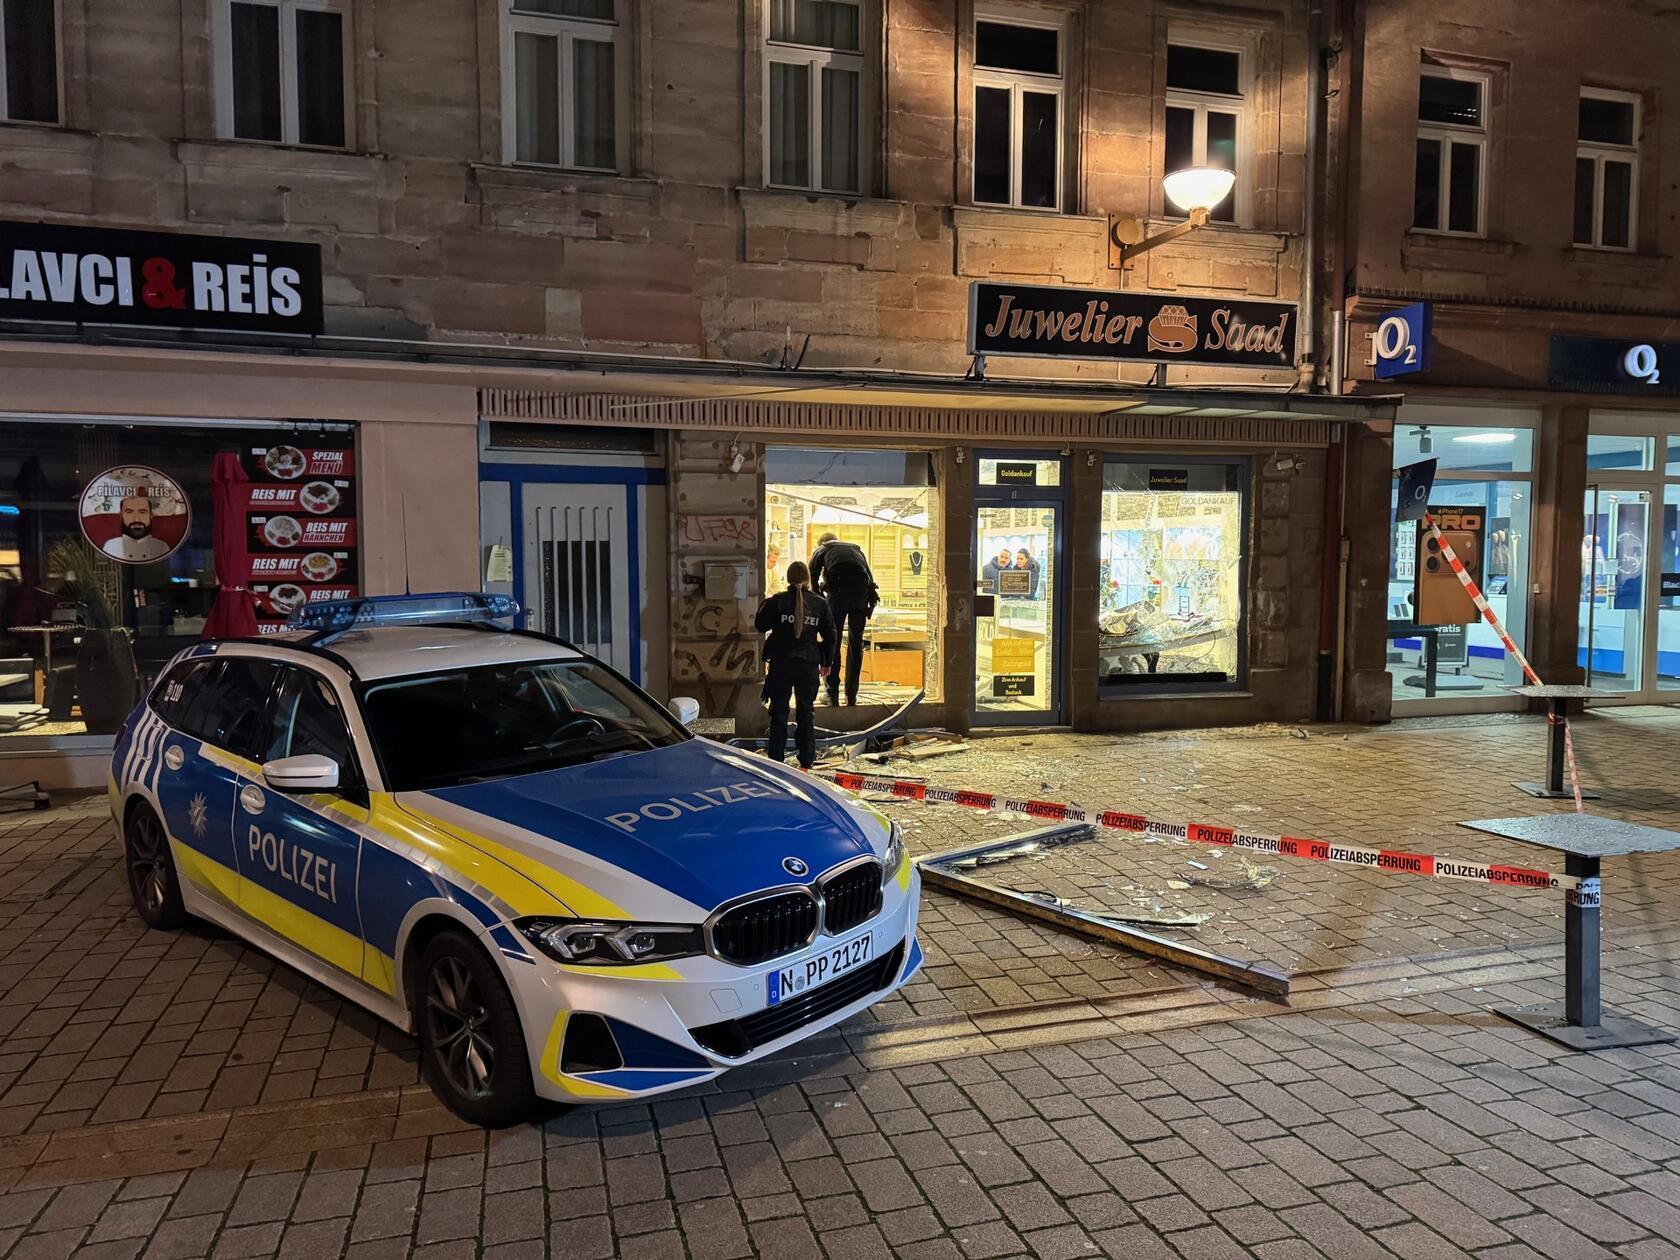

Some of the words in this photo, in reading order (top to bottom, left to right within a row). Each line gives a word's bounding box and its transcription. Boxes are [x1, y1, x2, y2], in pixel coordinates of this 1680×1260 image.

[141, 257, 187, 309] &
[985, 295, 1142, 344] Juwelier
[1204, 308, 1288, 353] Saad
[312, 451, 344, 461] SPEZIAL
[1000, 469, 1033, 478] Goldankauf
[251, 489, 275, 500] REIS
[276, 490, 297, 501] MIT
[1180, 496, 1235, 506] GOLDANKAUF
[306, 522, 329, 533] REIS
[328, 522, 349, 533] MIT
[1421, 514, 1481, 530] PRO
[252, 558, 277, 570] REIS
[278, 558, 301, 570] MIT
[310, 589, 332, 600] REIS
[332, 589, 351, 600] MIT
[781, 614, 820, 627] POZEI
[604, 780, 783, 833] POLIZEI
[851, 779, 917, 797] POLIZEIABSPERRUNG
[924, 788, 997, 808] POLIZEIABSPERRUNG
[1005, 800, 1086, 822] POLIZEIABSPERRUNG
[1096, 812, 1187, 837] POLIZEIABSPERRUNG
[1198, 828, 1298, 855] POLIZEIABSPERRUNG
[1310, 844, 1421, 872] POLIZEIABSPERRUNG
[248, 824, 338, 904] POLIZEI
[771, 990, 777, 999] D
[781, 969, 793, 996] N
[806, 956, 828, 985] PP
[832, 935, 871, 974] 2127
